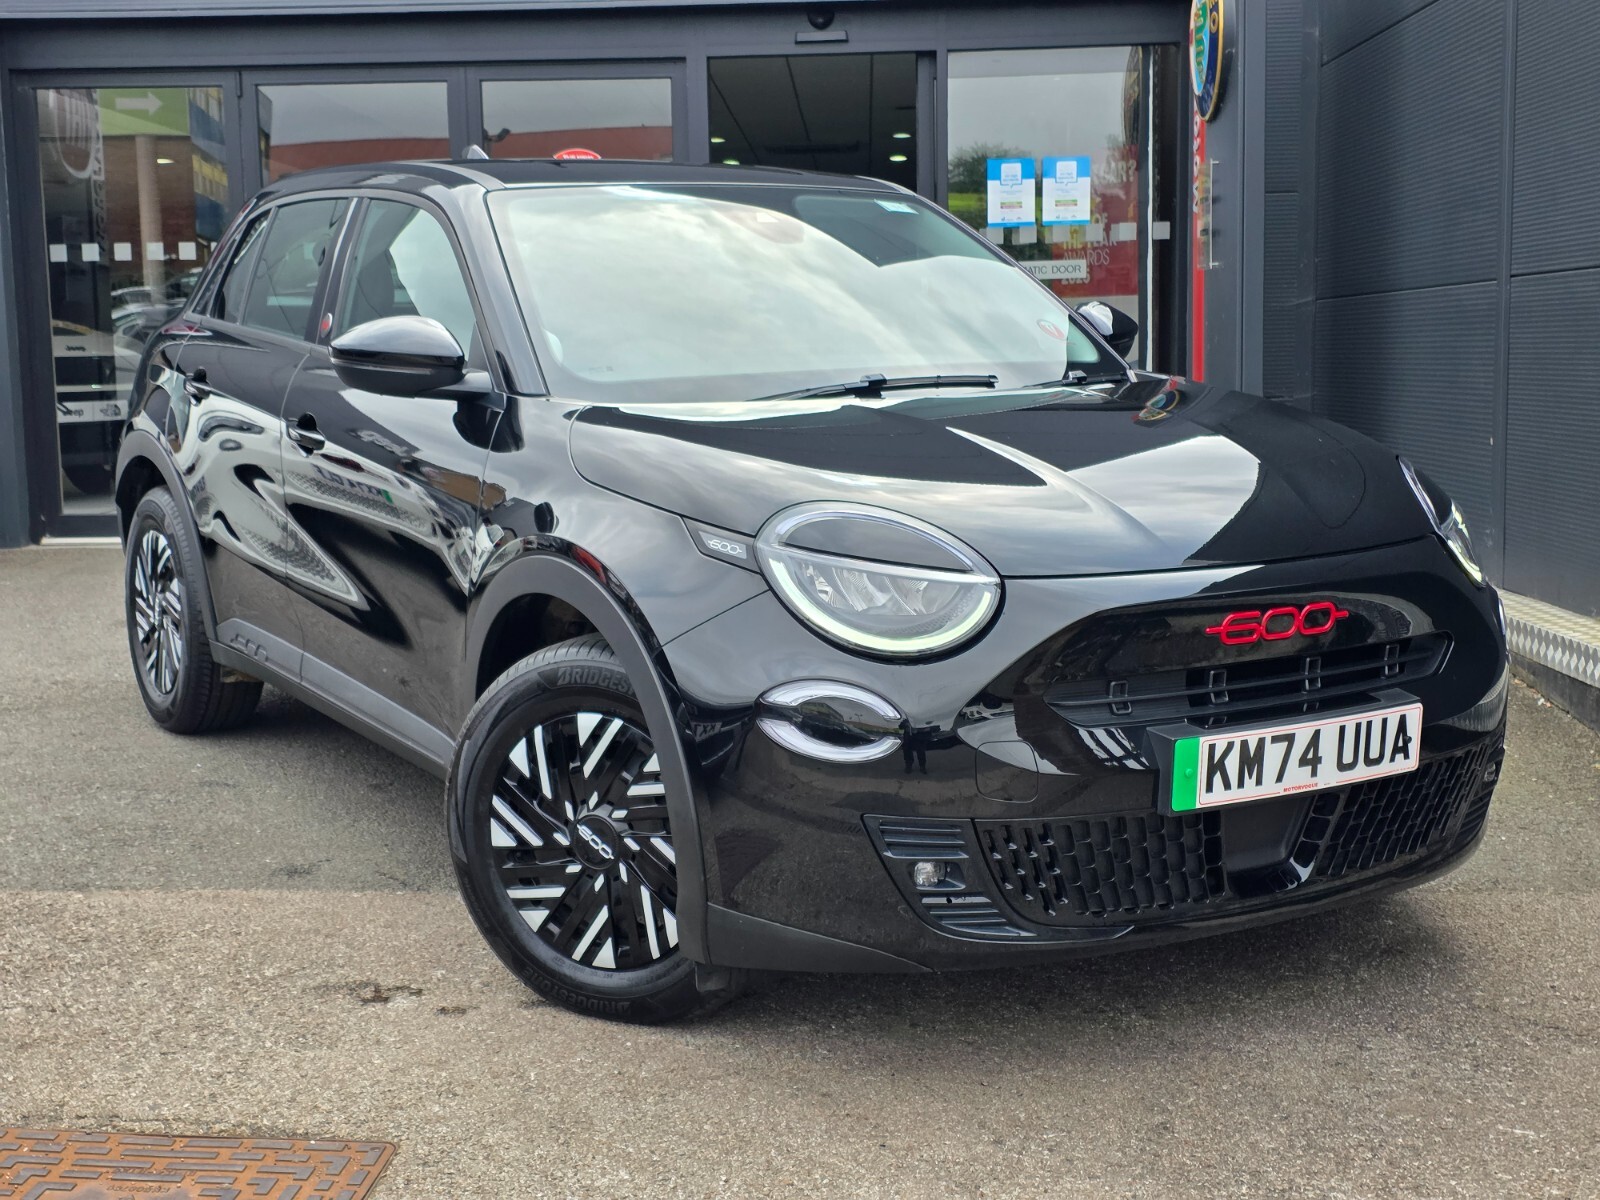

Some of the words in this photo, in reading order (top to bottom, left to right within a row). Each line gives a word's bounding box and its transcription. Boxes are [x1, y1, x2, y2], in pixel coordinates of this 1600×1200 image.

[1051, 264, 1082, 275] DOOR
[707, 540, 742, 554] 600
[1206, 602, 1349, 645] 600
[1205, 728, 1322, 794] KM74
[1336, 713, 1411, 773] UUA
[1283, 782, 1318, 793] MOTORVOGUE
[577, 823, 614, 859] 600
